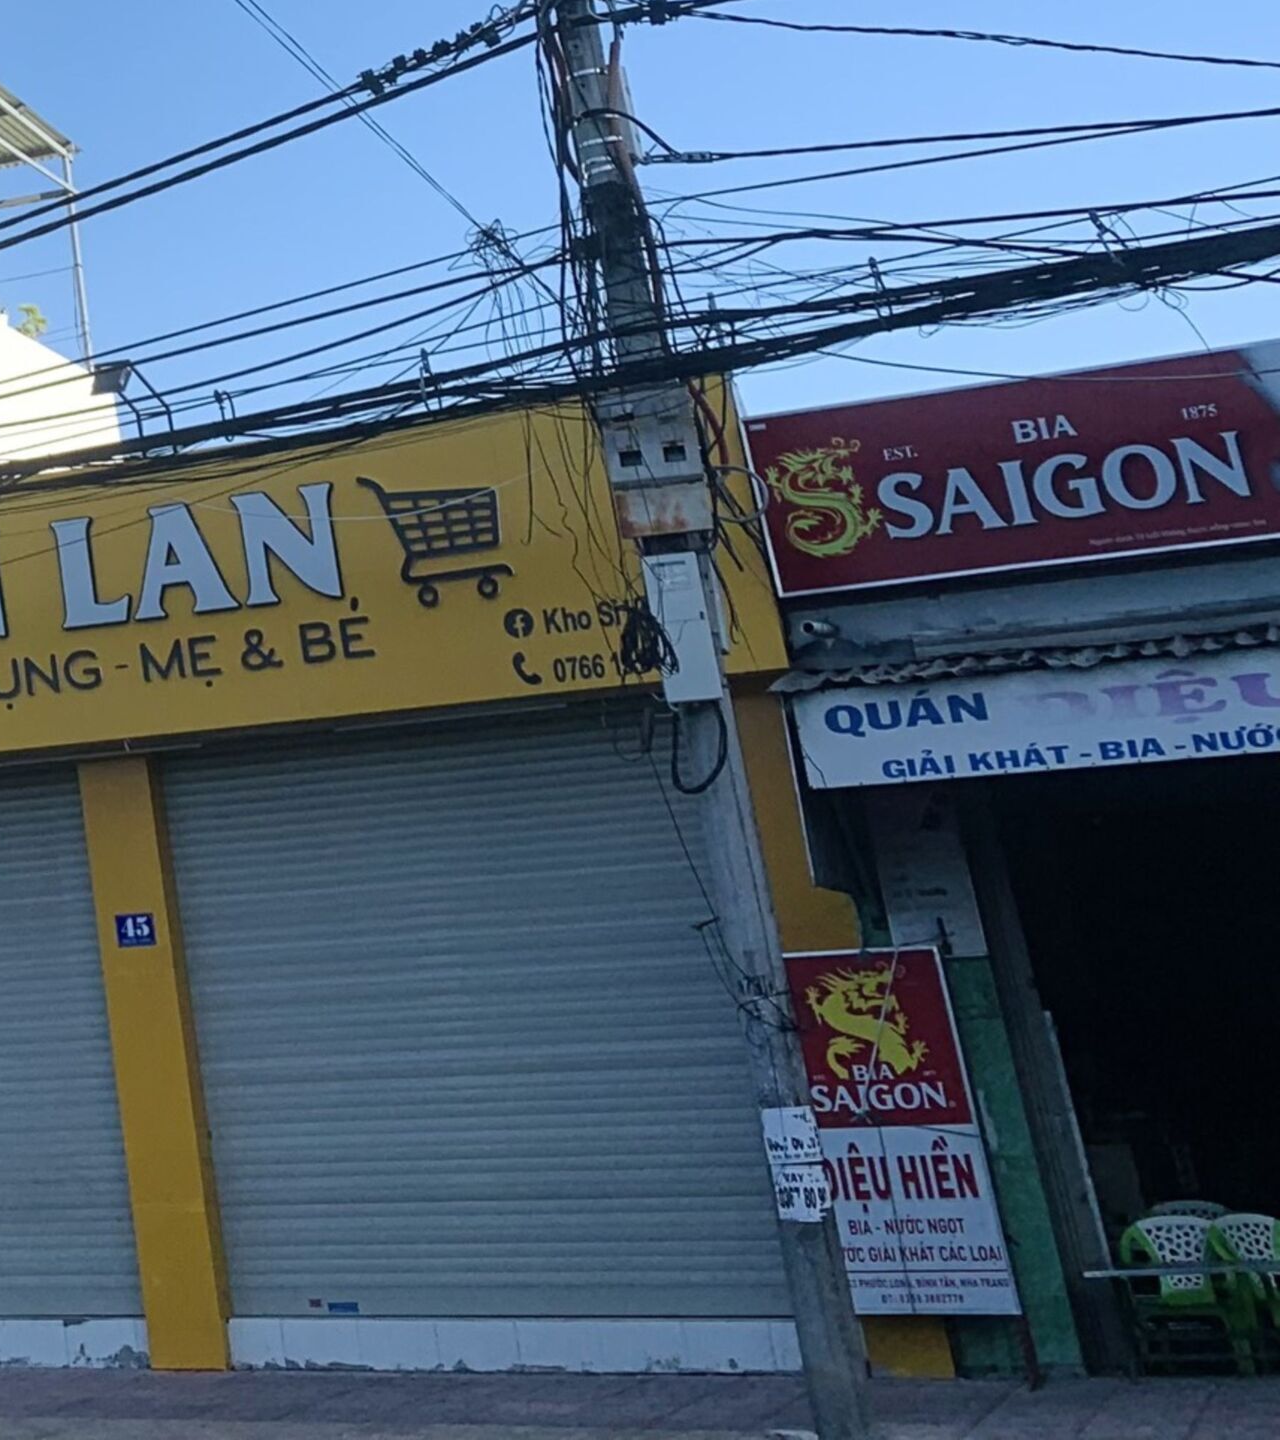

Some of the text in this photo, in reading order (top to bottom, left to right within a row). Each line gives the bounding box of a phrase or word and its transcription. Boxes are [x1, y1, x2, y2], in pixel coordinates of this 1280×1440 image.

[1181, 403, 1219, 420] 1875
[1010, 414, 1079, 444] BIA
[882, 445, 919, 461] EST.
[876, 430, 1252, 540] SAIGON
[50, 480, 344, 632] LAN
[542, 606, 592, 635] Kho
[139, 635, 223, 689] MẸ
[240, 629, 284, 672] &
[298, 596, 377, 663] BÉ
[552, 653, 606, 683] 0766
[823, 690, 990, 738] QUÁN
[881, 749, 958, 779] GIẢI
[969, 741, 1070, 774] KHÁT
[1098, 737, 1166, 761] BIA
[1191, 722, 1280, 753] NƯỚ
[121, 916, 151, 937] 45
[851, 1063, 896, 1082] BIA
[809, 1081, 949, 1114] SAIGON
[896, 1135, 981, 1200] HIỀN
[848, 1213, 965, 1239] BIA NƯỚC NGỌT
[869, 1241, 1004, 1266] GIẢI KHÁT CÁC LOẠI
